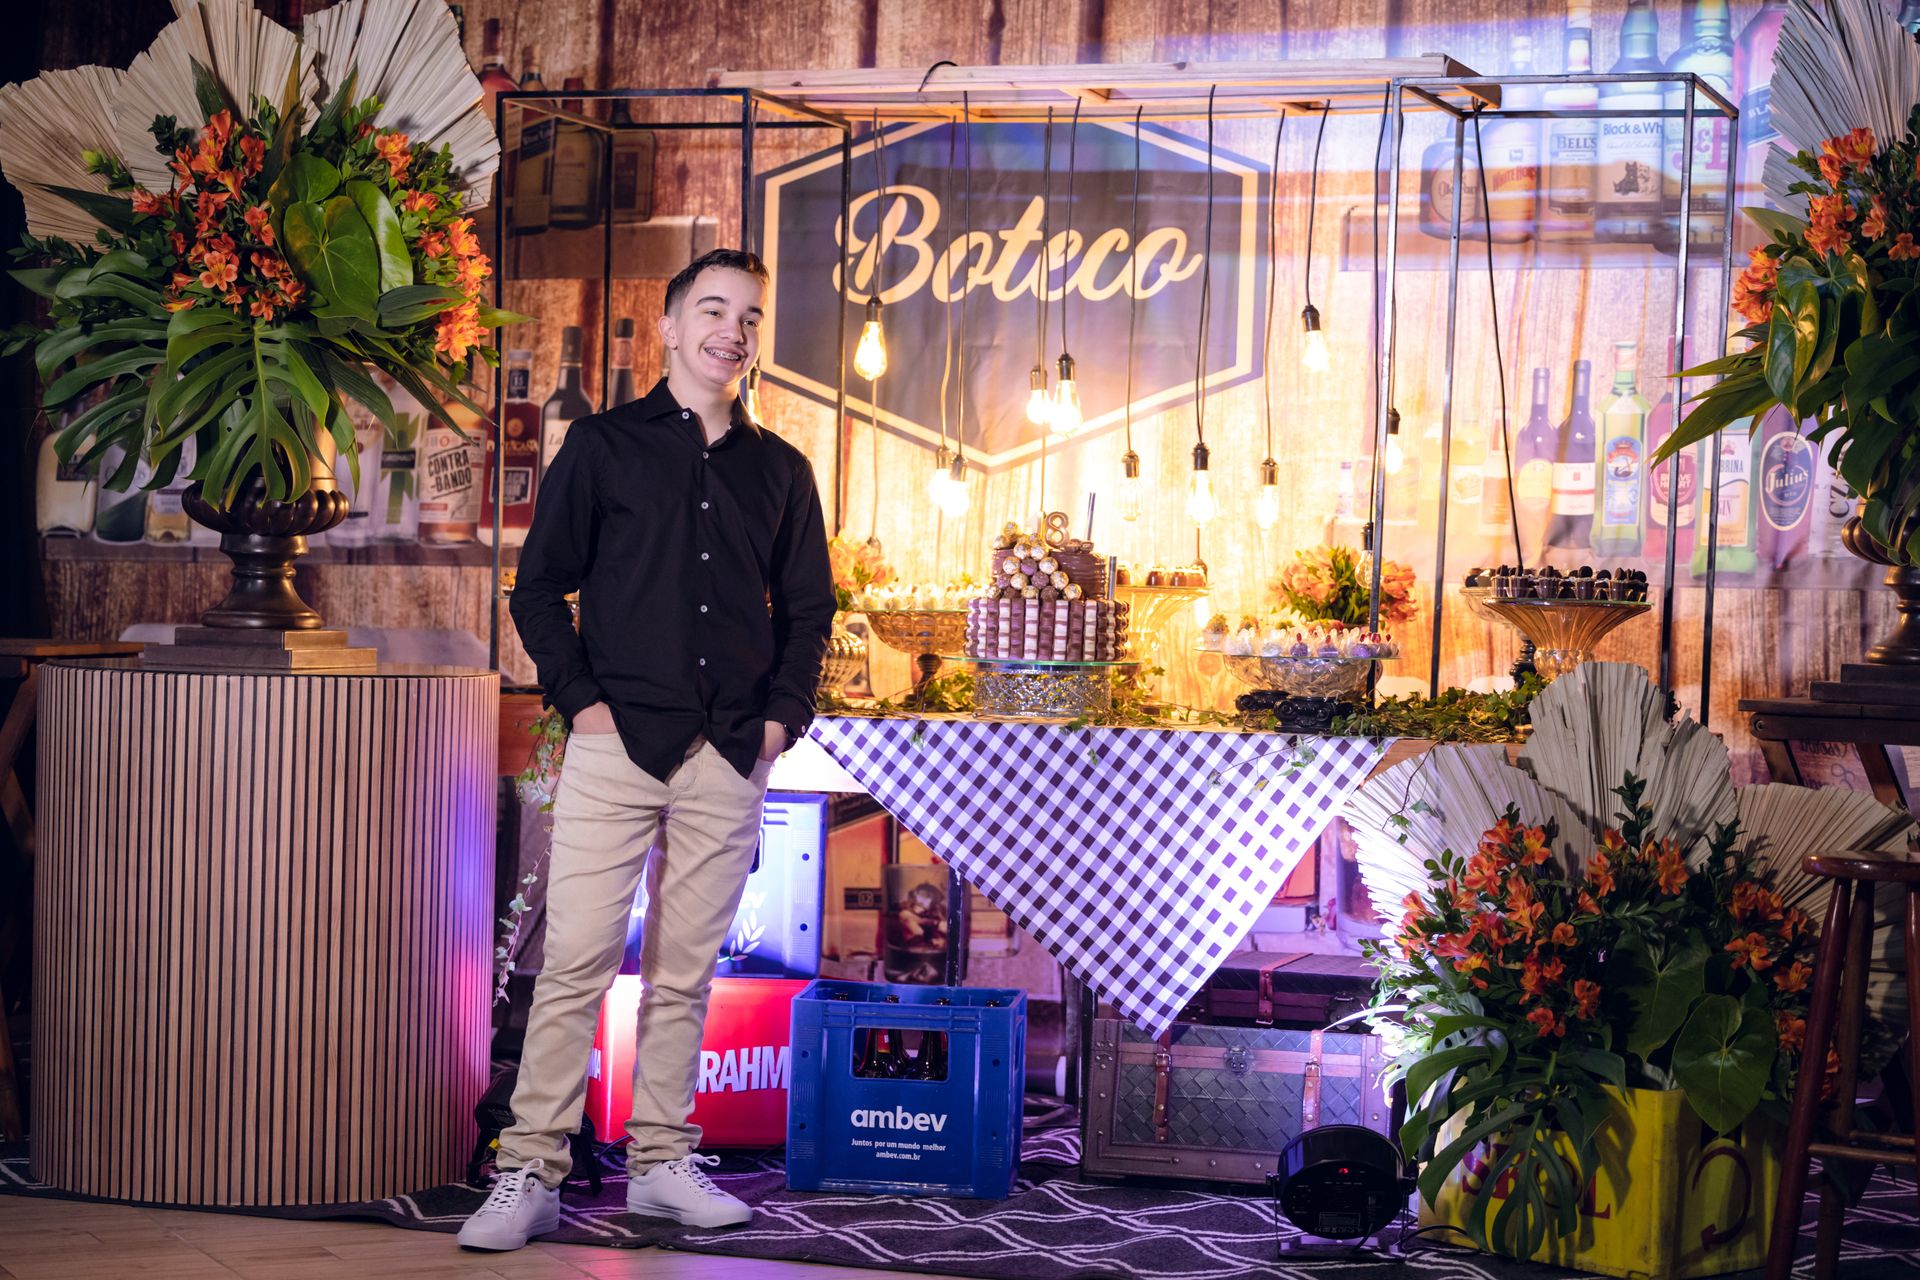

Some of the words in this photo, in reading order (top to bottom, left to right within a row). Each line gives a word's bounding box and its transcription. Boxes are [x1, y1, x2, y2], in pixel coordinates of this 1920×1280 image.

[1603, 122, 1631, 135] Black
[1632, 123, 1641, 135] &
[1557, 136, 1597, 149] BELL'S
[832, 185, 1202, 304] Boteco
[428, 449, 470, 477] CONTRA
[1660, 473, 1692, 481] BRVE
[1765, 470, 1809, 493] Julius
[1660, 481, 1691, 489] HERT
[695, 1046, 790, 1094] RAHM
[850, 1105, 948, 1132] ambev
[851, 1138, 873, 1147] Juntos
[874, 1141, 886, 1149] por
[897, 1142, 921, 1150] mundo
[922, 1143, 946, 1151] melhor
[875, 1151, 921, 1161] ambev.com.br
